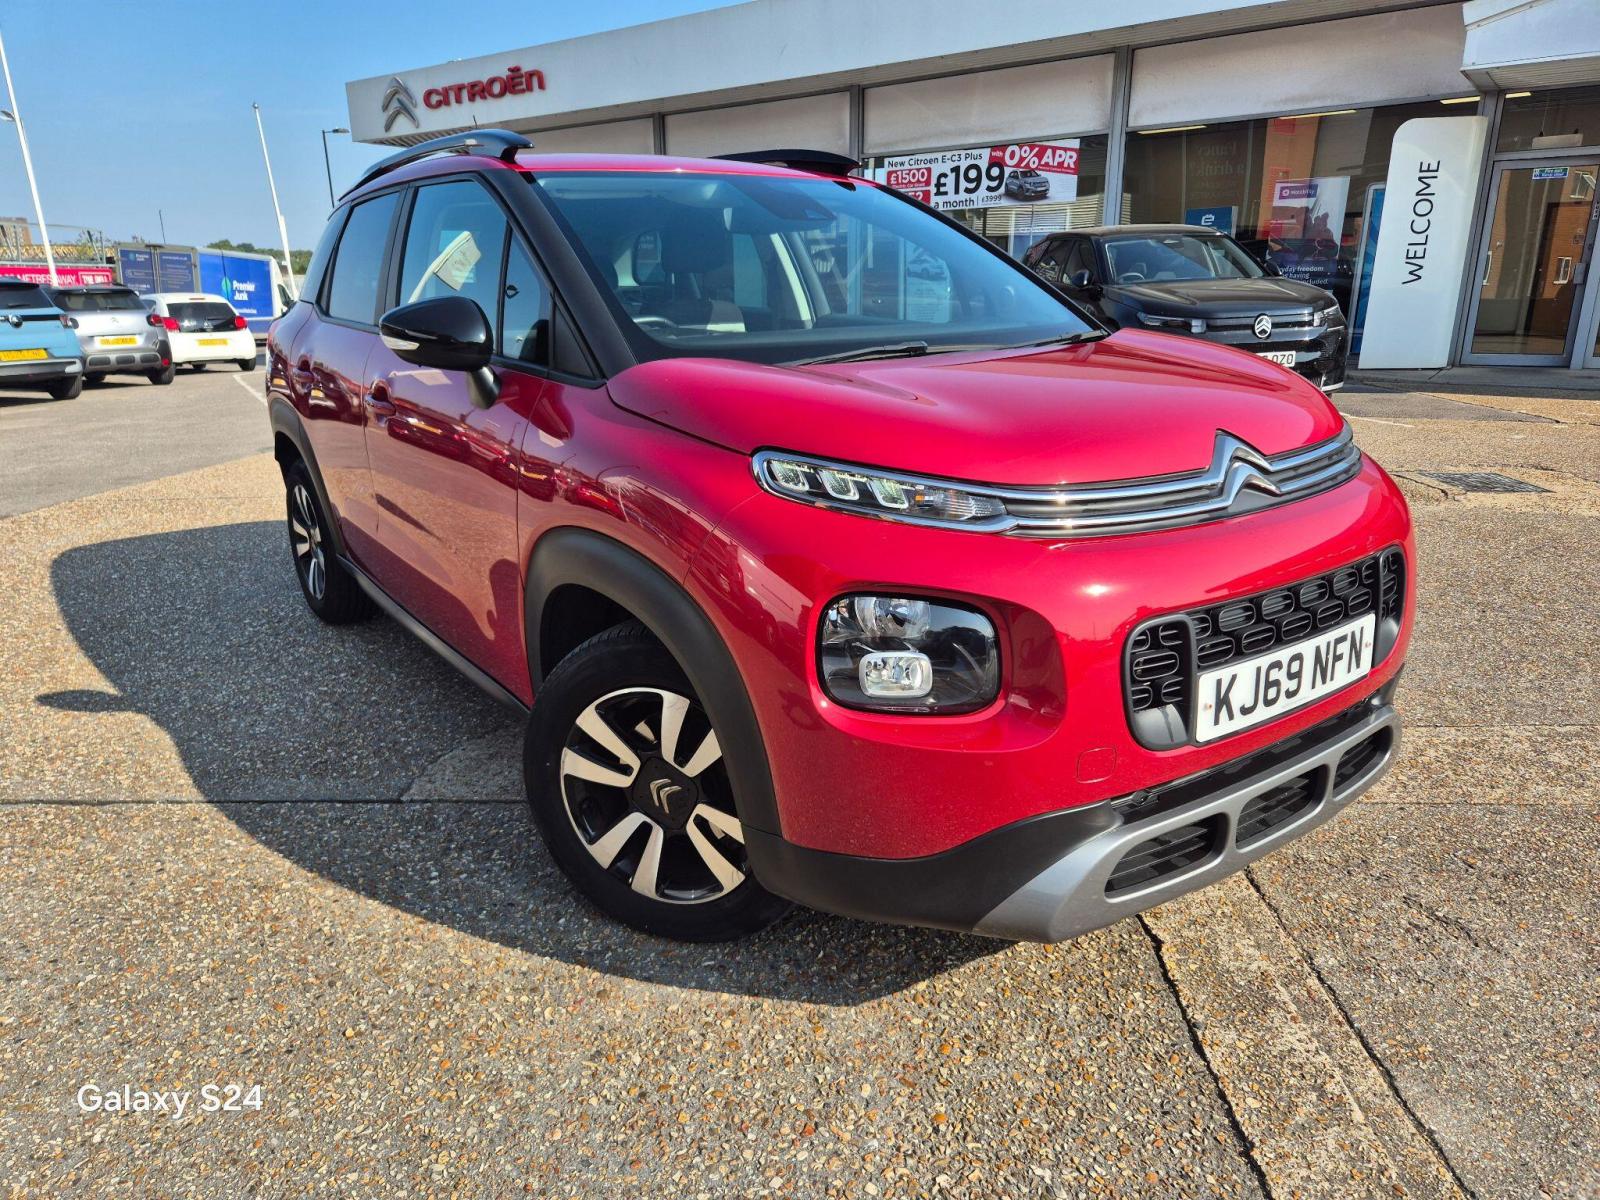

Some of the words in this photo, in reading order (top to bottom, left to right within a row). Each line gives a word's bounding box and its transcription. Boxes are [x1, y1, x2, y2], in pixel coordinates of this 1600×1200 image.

[887, 159, 906, 168] New
[908, 156, 939, 167] Citroen
[941, 153, 962, 164] E-C3
[964, 152, 983, 161] Plus
[1004, 145, 1039, 169] 0%
[1040, 149, 1077, 169] APR
[890, 168, 928, 185] £1500
[934, 163, 1005, 197] £199
[934, 201, 940, 210] a
[942, 198, 975, 209] month
[982, 194, 1002, 203] £3999
[1401, 160, 1441, 285] WELCOME
[1297, 265, 1324, 273] freedom
[1213, 652, 1304, 727] KJ69
[1311, 626, 1364, 690] NFN
